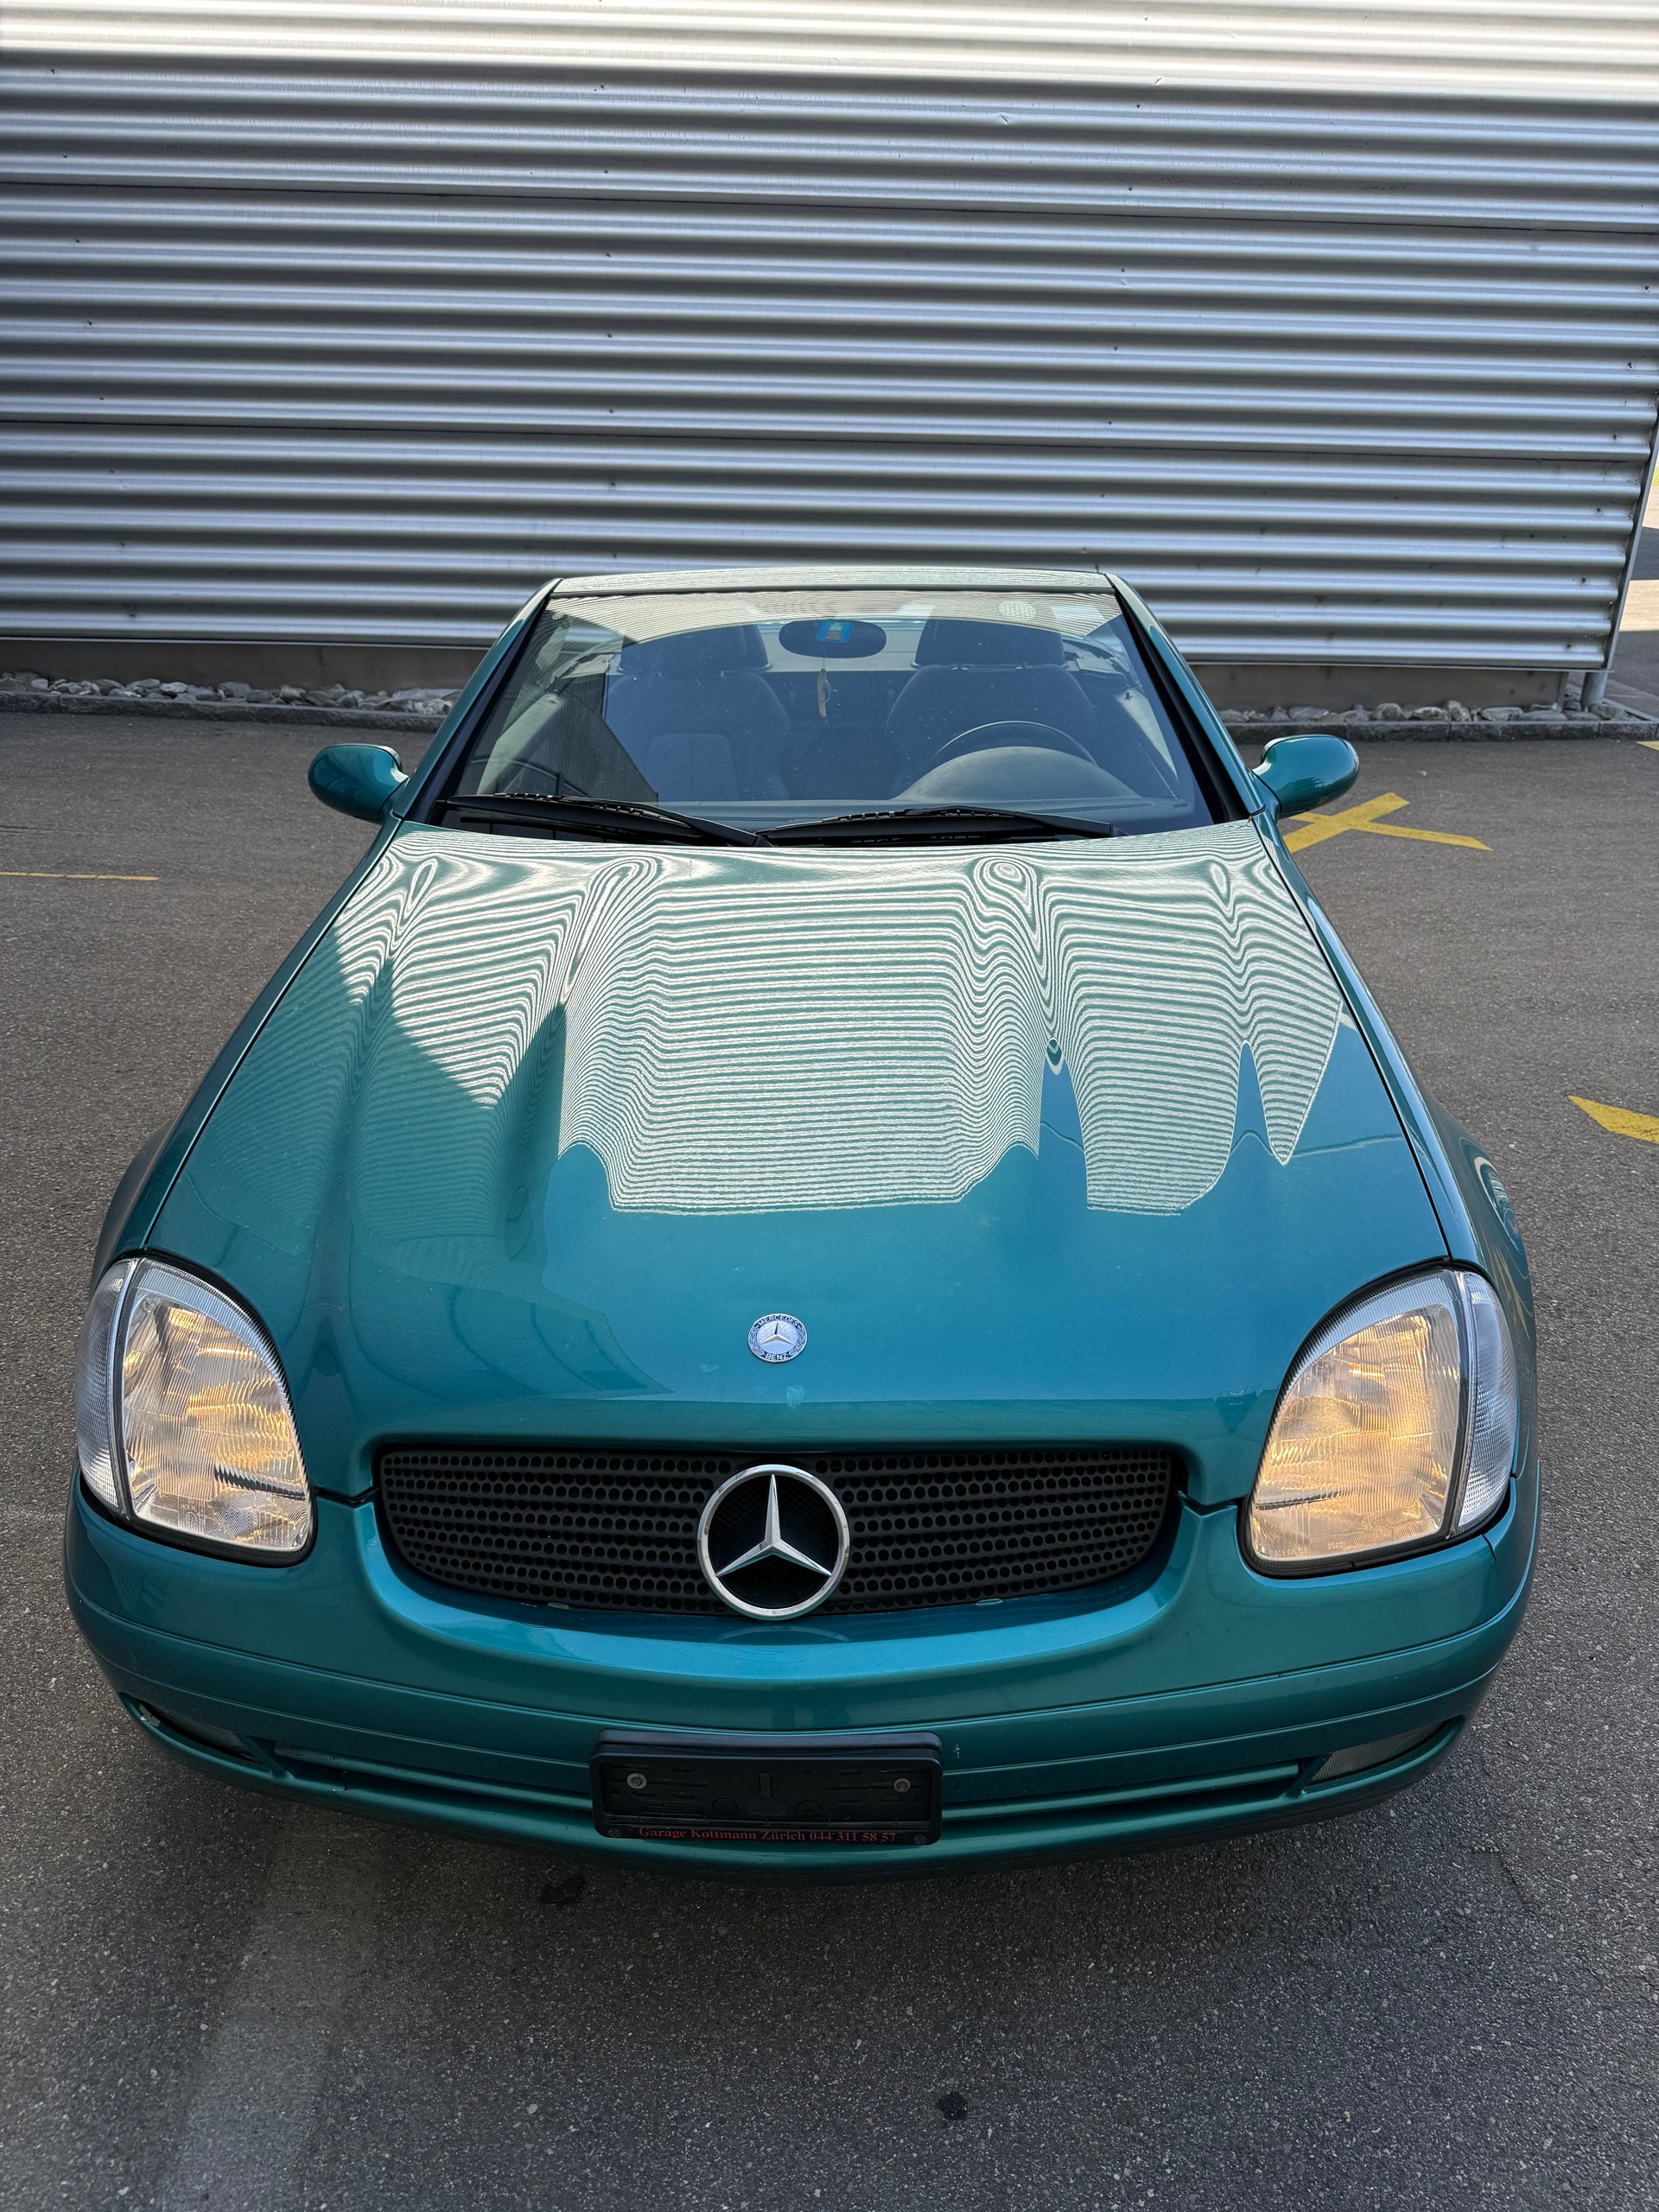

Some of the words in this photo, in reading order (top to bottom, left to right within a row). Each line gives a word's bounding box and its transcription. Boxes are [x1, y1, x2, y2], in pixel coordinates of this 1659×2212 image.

[757, 1314, 799, 1326] MERCEDES
[639, 1827, 687, 1839] Garage
[690, 1828, 757, 1840] Kottmann
[760, 1829, 806, 1840] Zürich
[836, 1832, 858, 1842] 311
[861, 1833, 878, 1842] 58
[881, 1833, 897, 1842] 57
